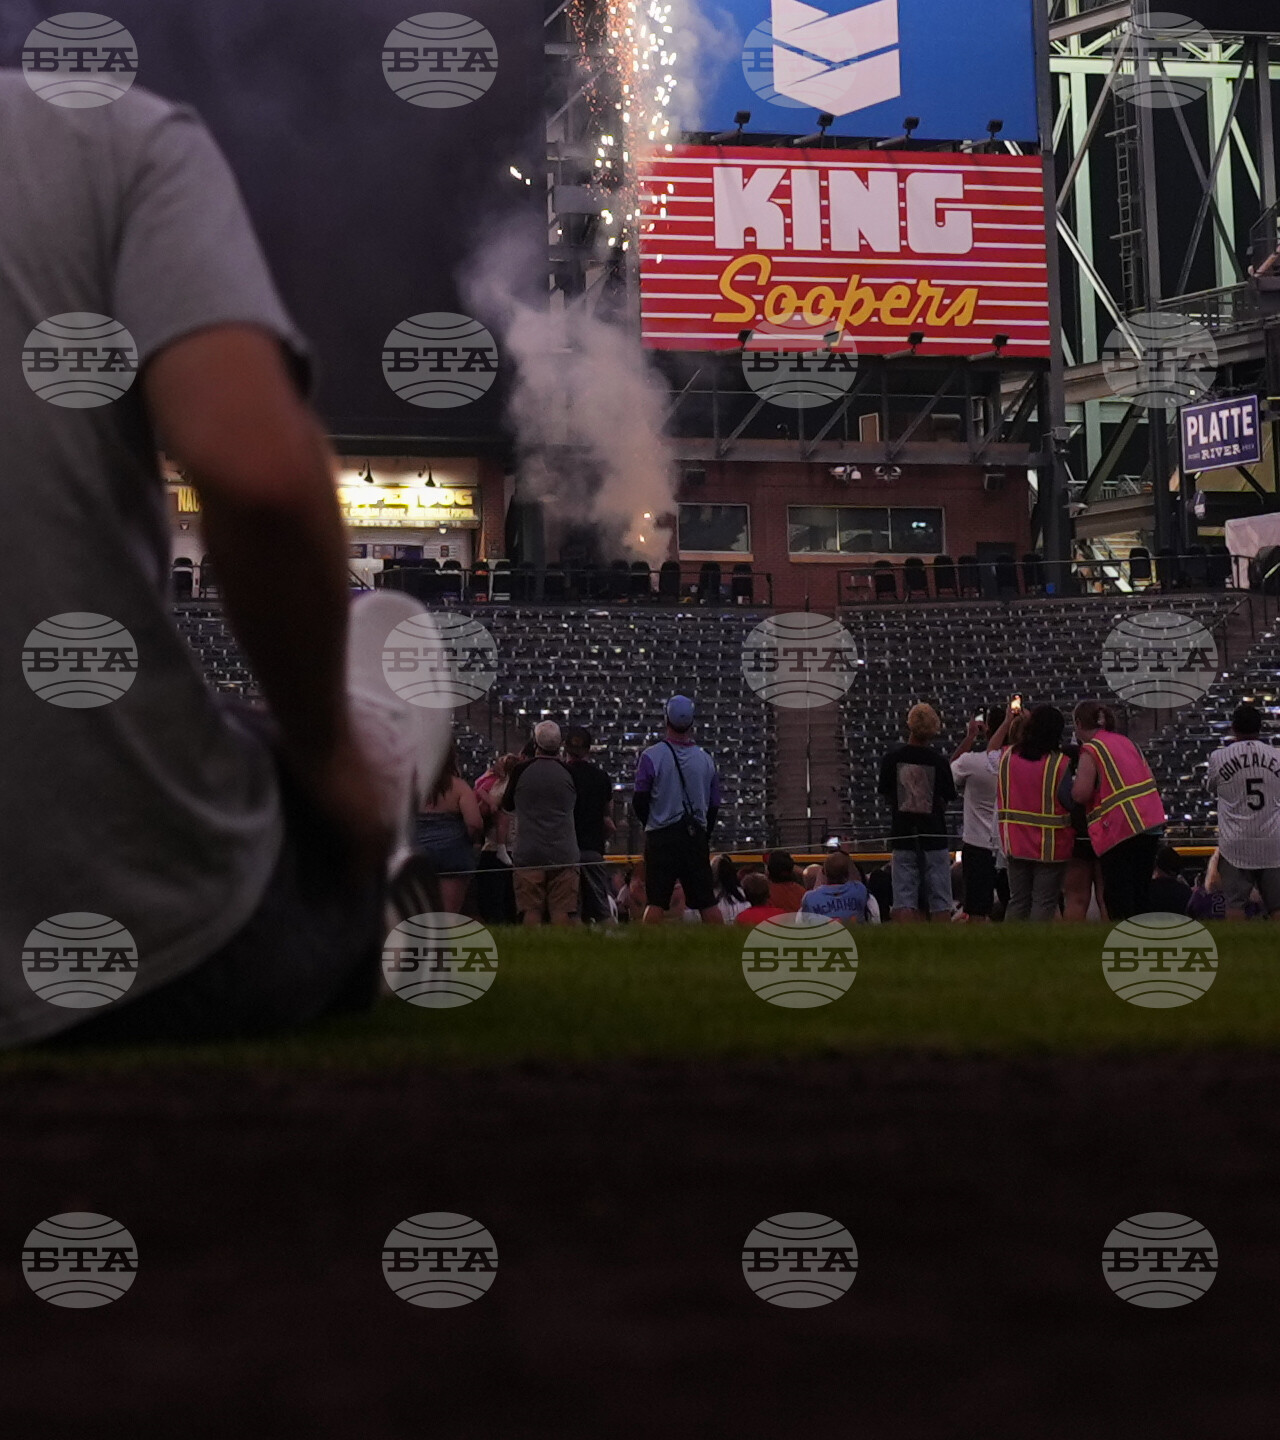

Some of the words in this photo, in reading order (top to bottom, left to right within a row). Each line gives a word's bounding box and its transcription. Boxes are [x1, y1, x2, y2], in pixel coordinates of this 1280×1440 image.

[712, 166, 974, 254] KING
[712, 253, 978, 345] Soopers
[1187, 405, 1254, 446] PLATTE
[1201, 444, 1241, 460] RIVER
[1246, 778, 1265, 811] 5
